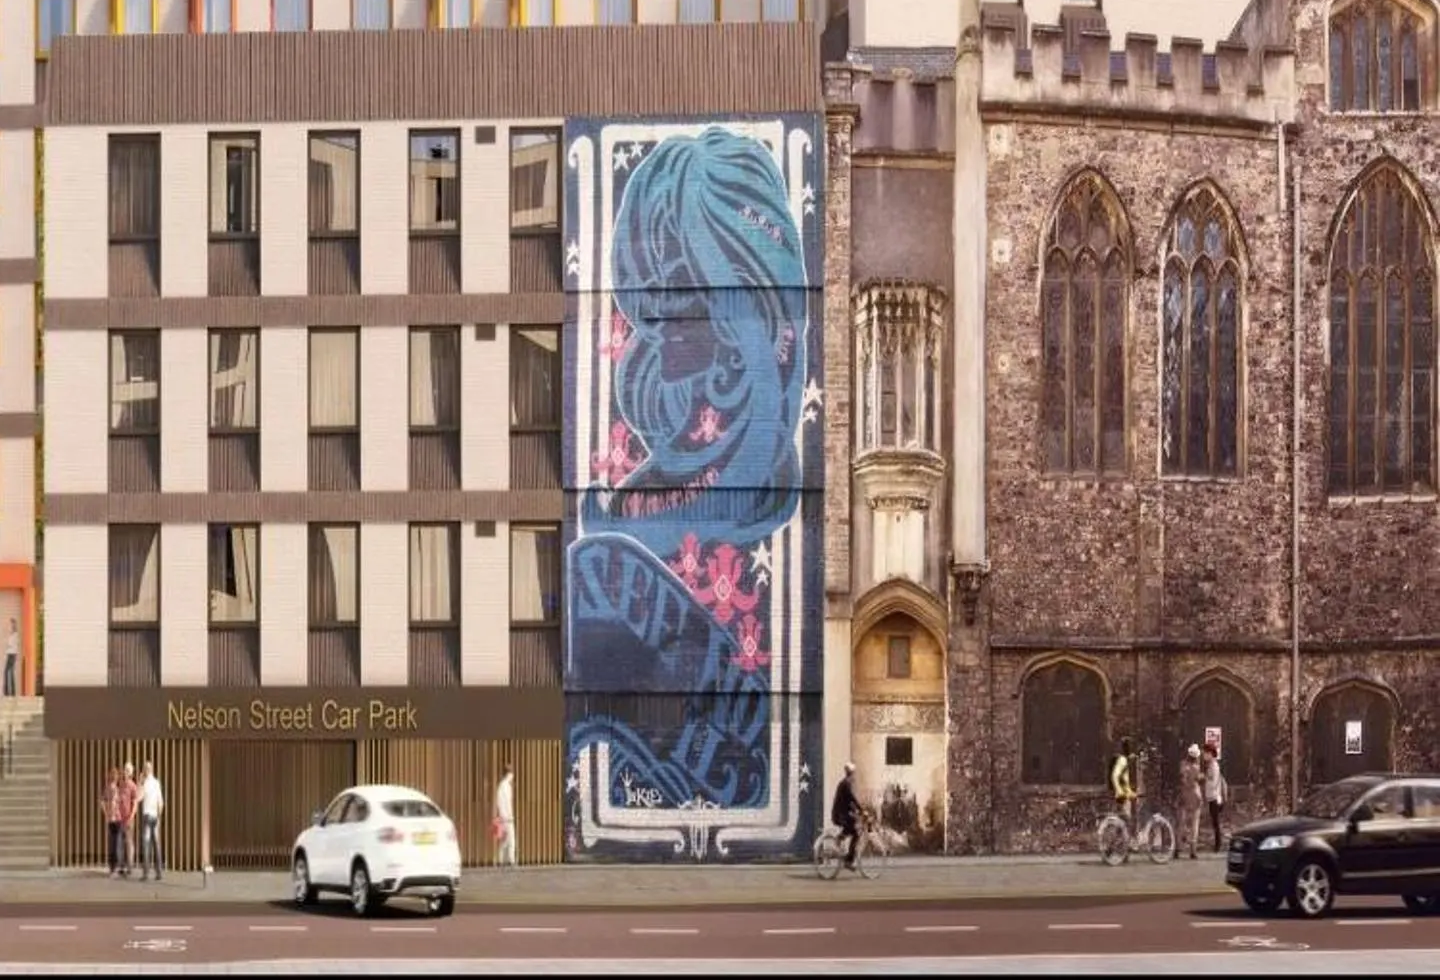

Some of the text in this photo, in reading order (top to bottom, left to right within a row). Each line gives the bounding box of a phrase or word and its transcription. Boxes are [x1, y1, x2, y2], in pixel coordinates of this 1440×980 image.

[167, 700, 418, 729] Nelson Street Car Park
